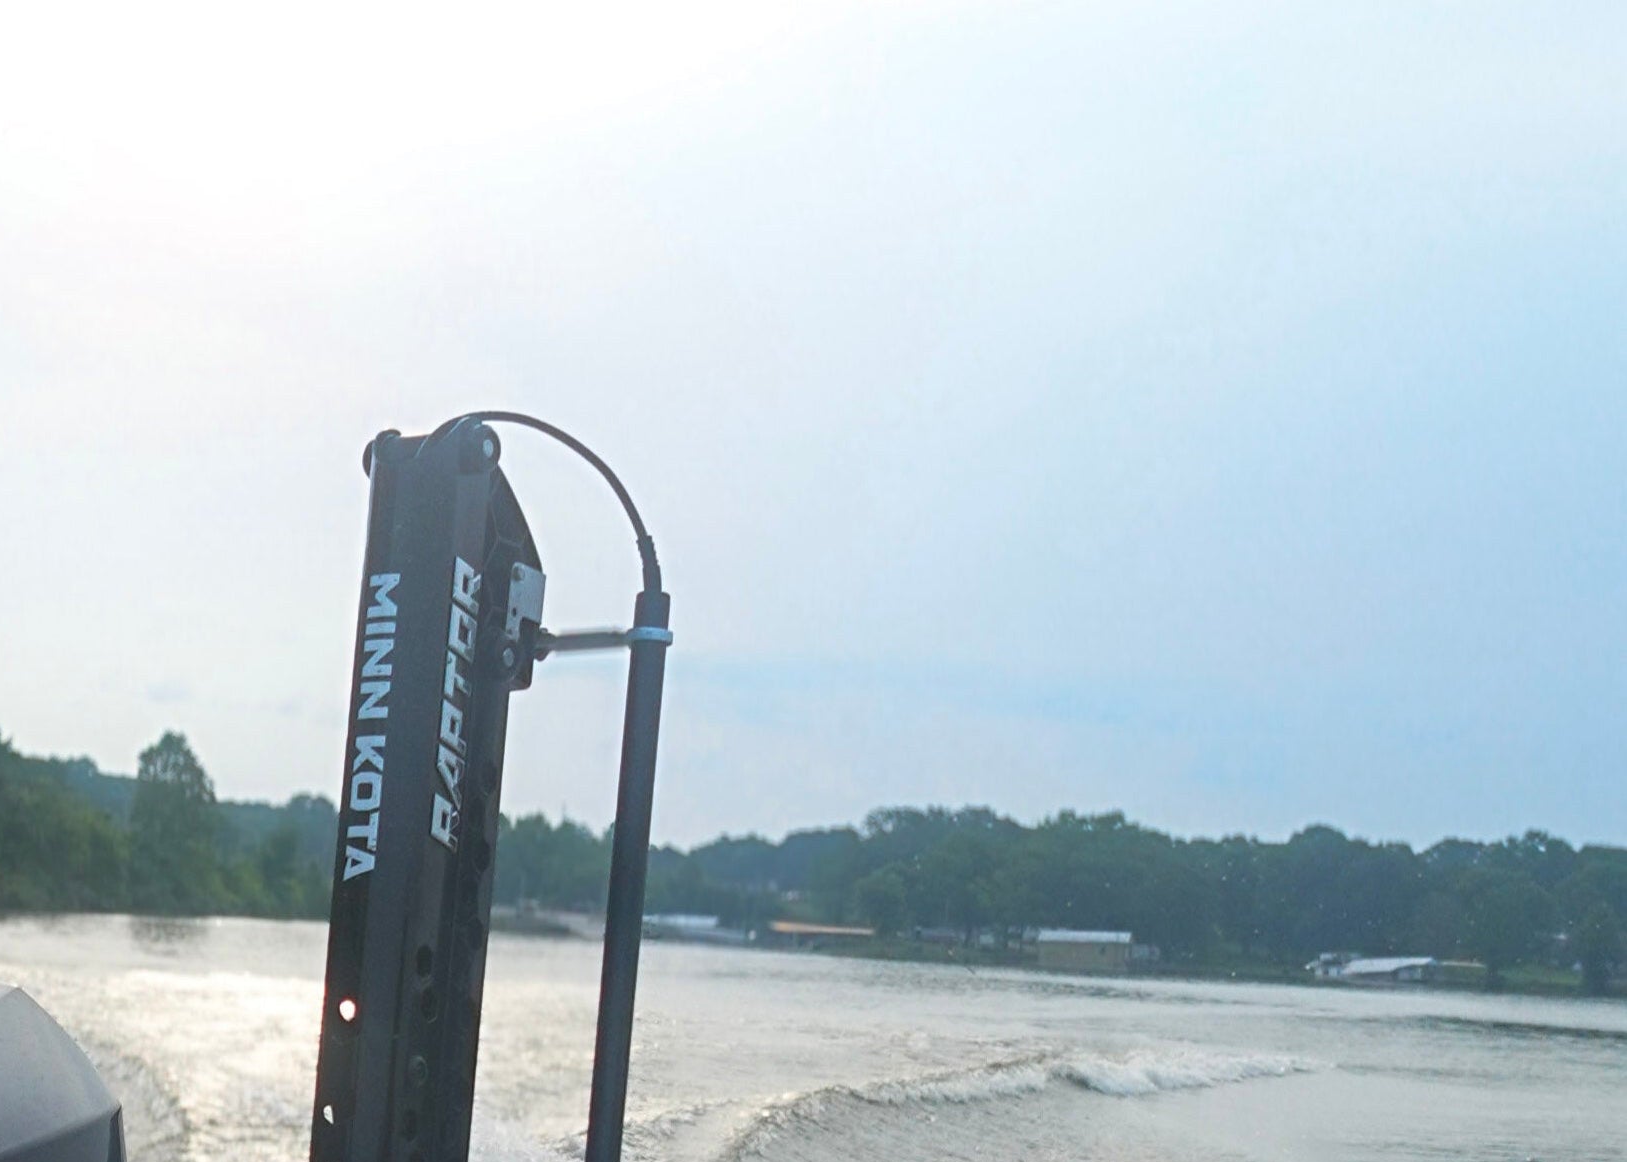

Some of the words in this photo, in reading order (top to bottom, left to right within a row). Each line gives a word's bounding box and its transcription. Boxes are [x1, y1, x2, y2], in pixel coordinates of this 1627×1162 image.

[357, 573, 400, 720] MINN
[431, 556, 481, 853] RAPTOR
[343, 735, 386, 881] KOTA
